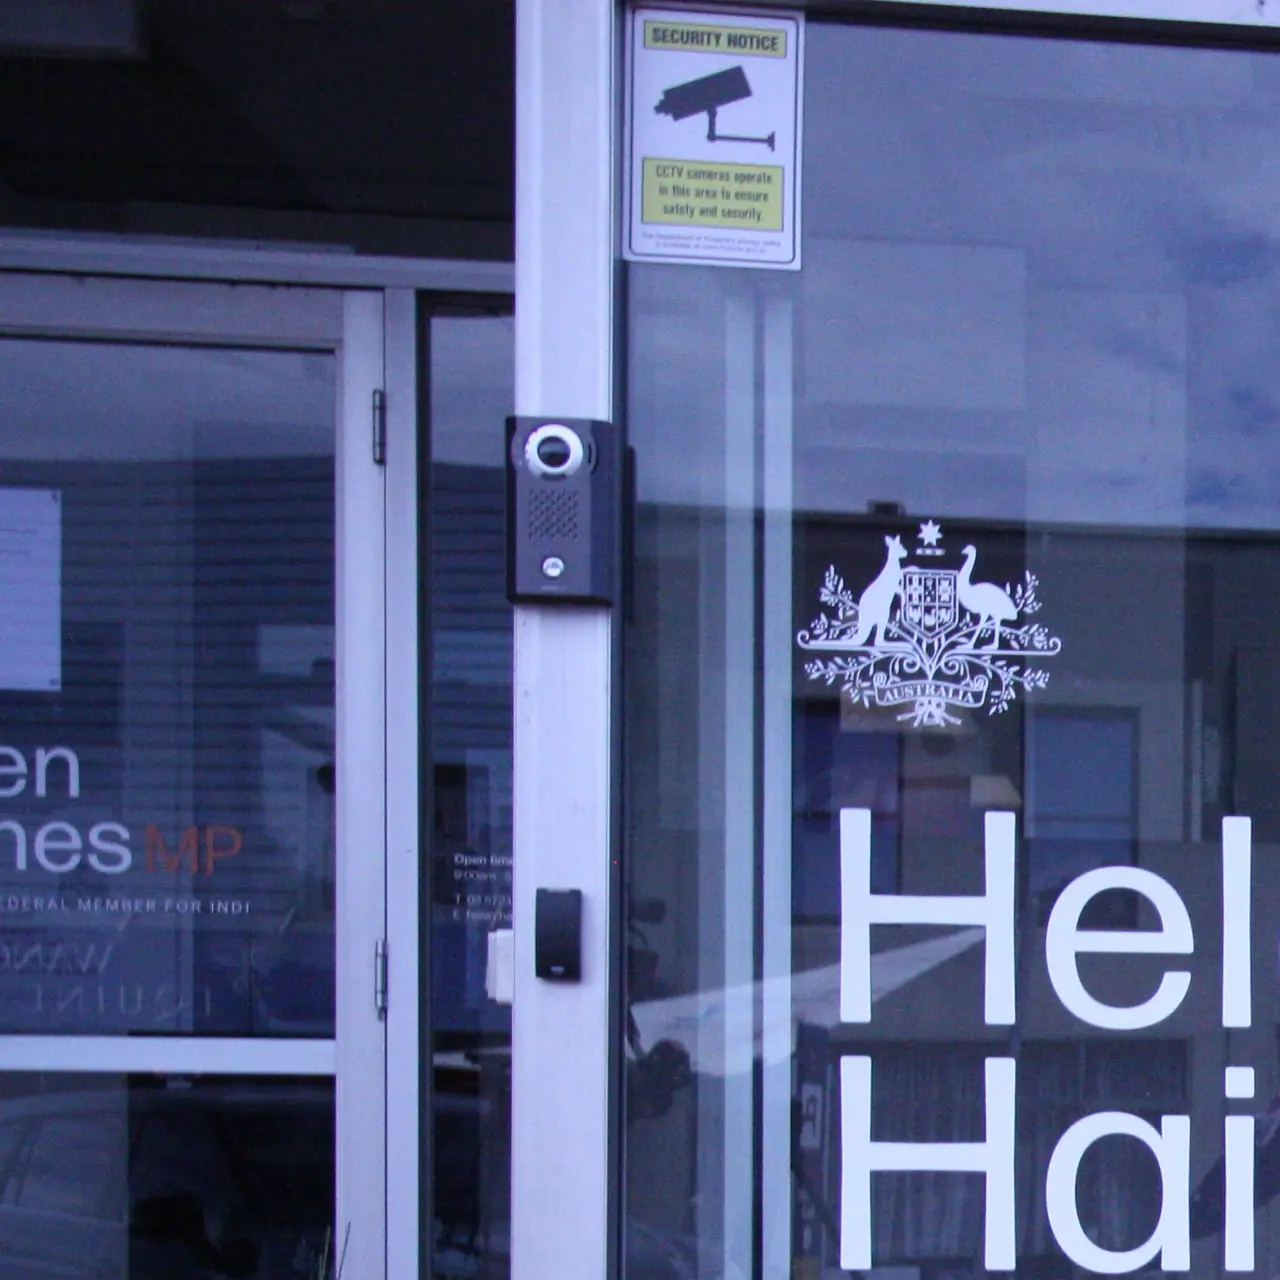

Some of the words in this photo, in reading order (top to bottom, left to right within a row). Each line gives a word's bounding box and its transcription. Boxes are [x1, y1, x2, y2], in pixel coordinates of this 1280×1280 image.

[651, 27, 723, 48] SECURITY
[727, 33, 780, 51] NOTICE
[655, 164, 684, 178] CCTV
[687, 168, 730, 181] cameras
[734, 172, 772, 186] operate
[659, 184, 668, 197] in
[672, 184, 690, 197] this
[694, 188, 717, 199] area
[721, 188, 731, 200] to
[734, 190, 769, 202] ensure
[663, 203, 696, 218] safety
[699, 204, 717, 218] and
[883, 683, 975, 704] AUSTRALIA
[145, 823, 243, 877] MP
[165, 899, 202, 914] FOR
[210, 900, 250, 915] INDI
